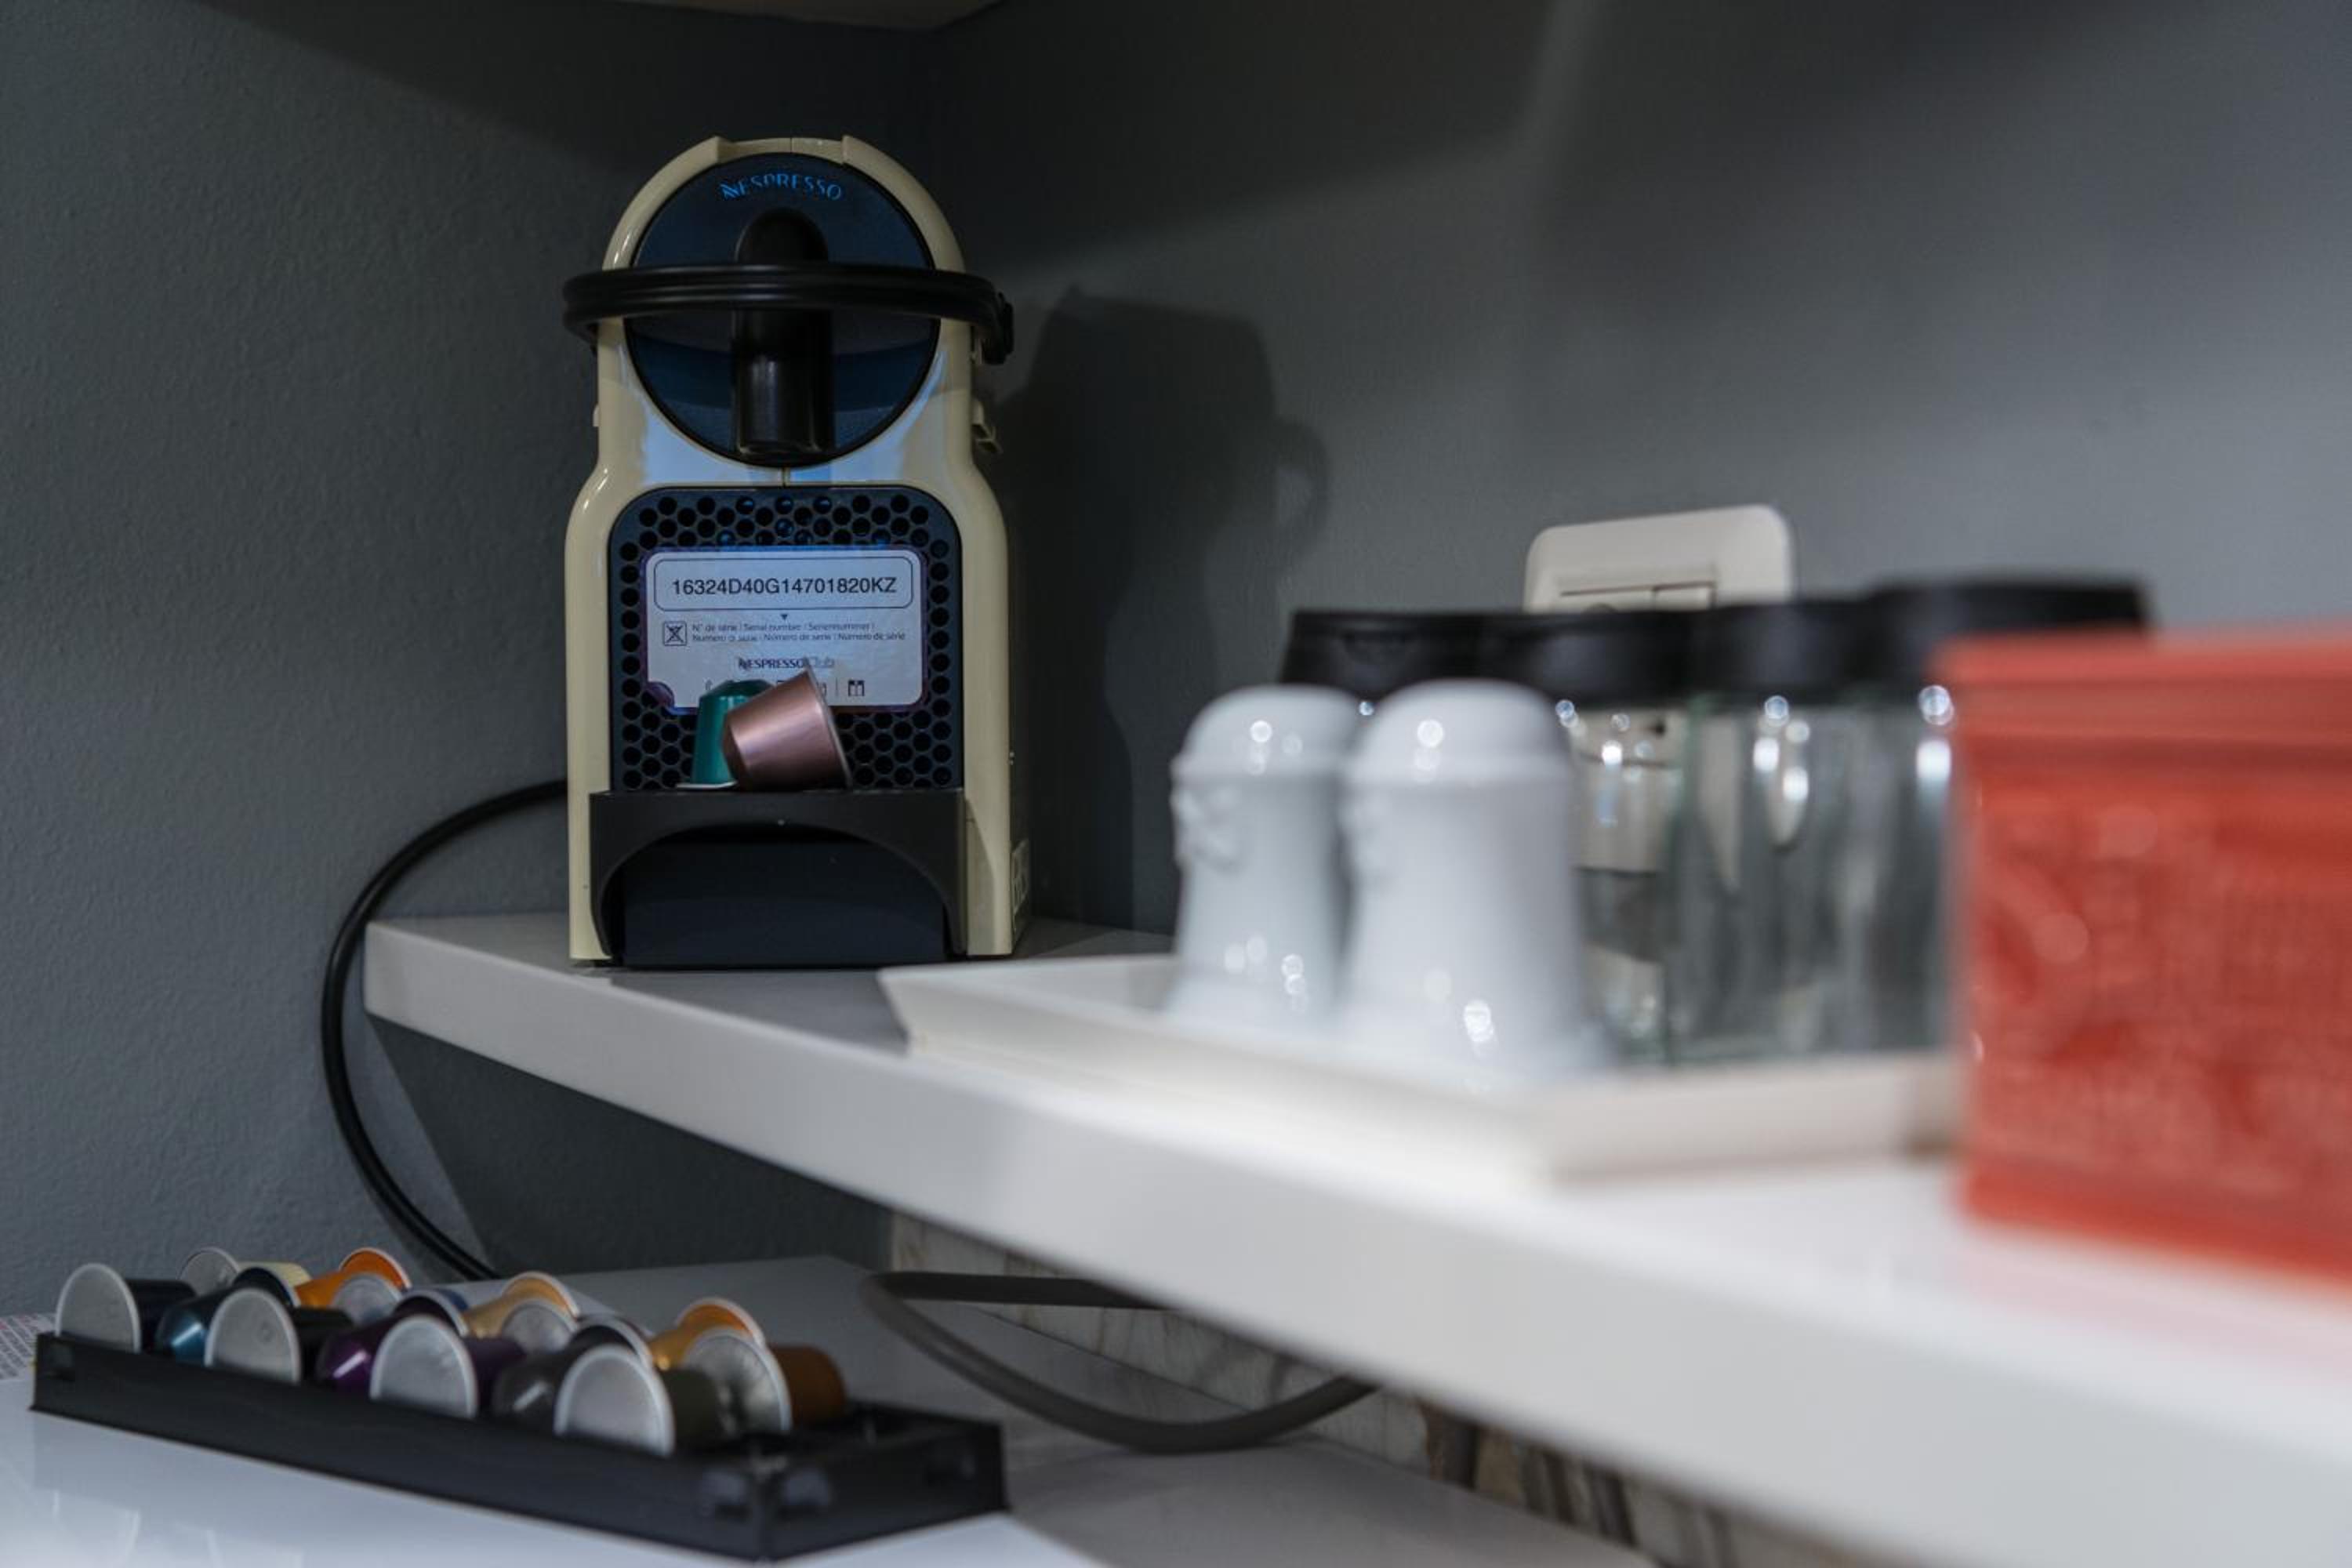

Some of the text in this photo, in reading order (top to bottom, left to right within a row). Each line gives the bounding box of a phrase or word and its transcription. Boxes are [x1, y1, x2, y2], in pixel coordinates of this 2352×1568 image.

[720, 172, 841, 200] NESPRESSO
[672, 577, 897, 595] 16324D40G14701820KZ
[873, 632, 884, 641] de
